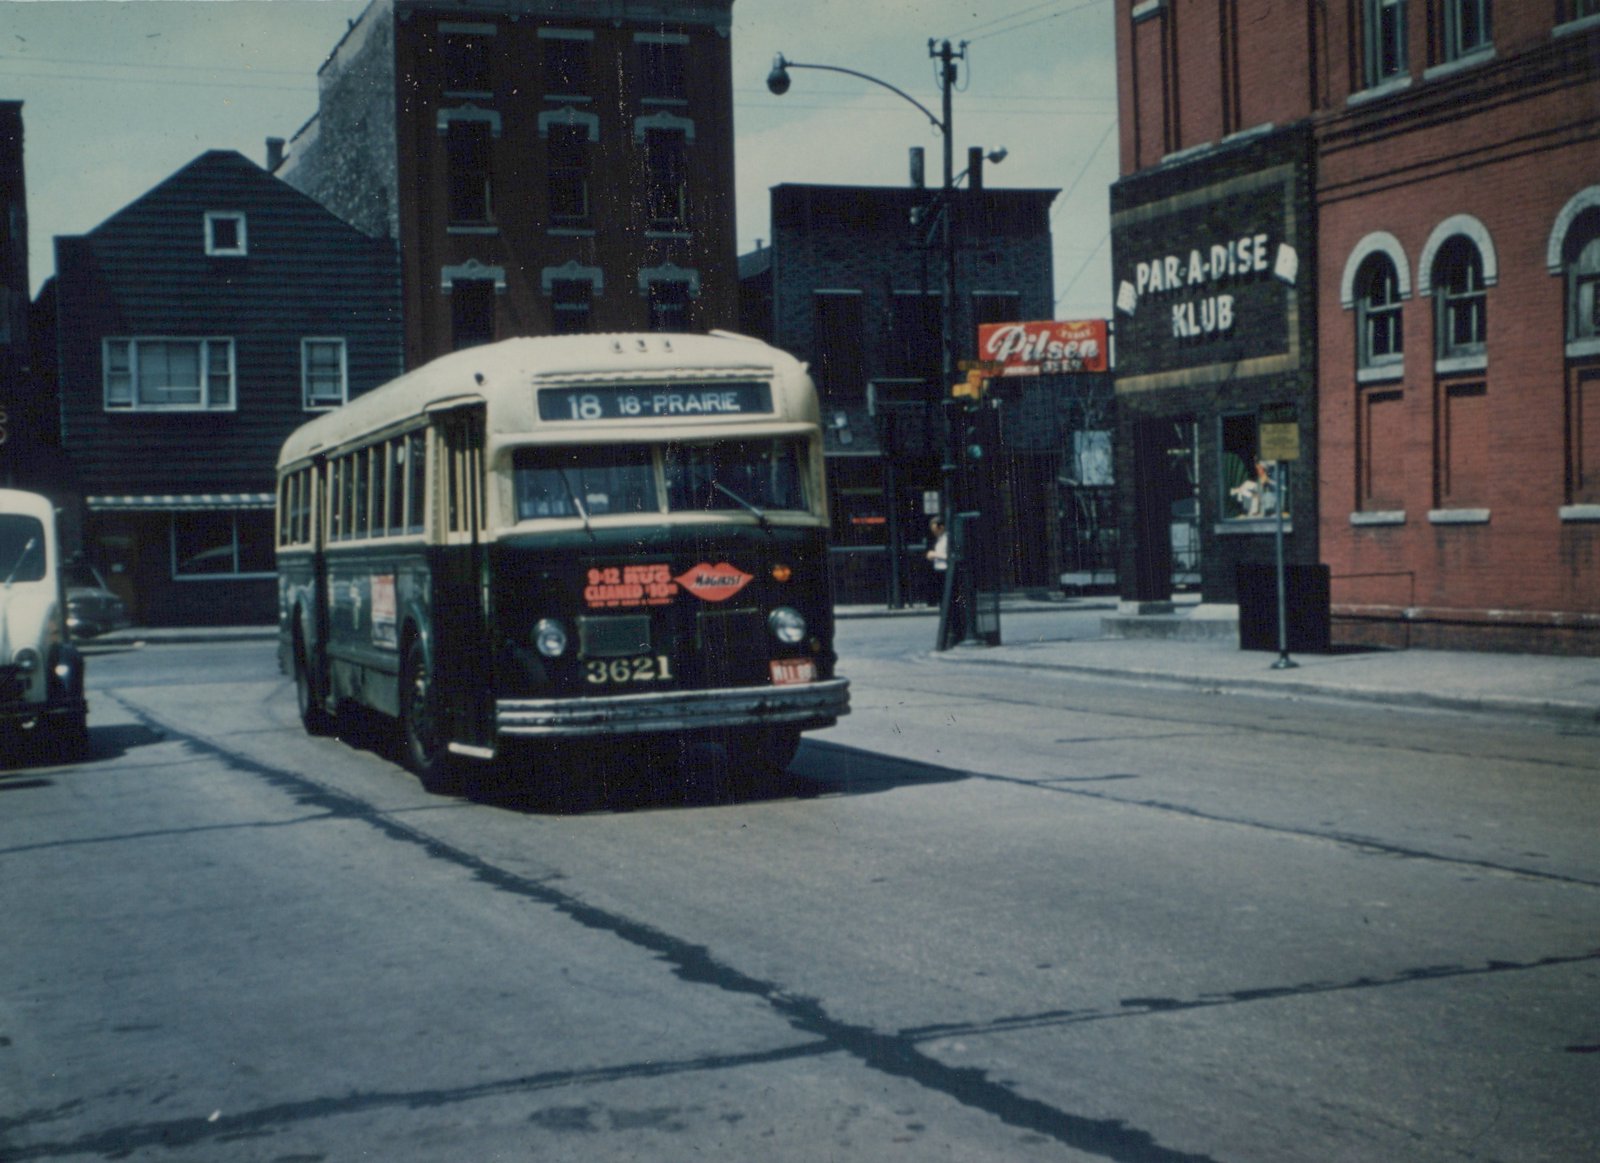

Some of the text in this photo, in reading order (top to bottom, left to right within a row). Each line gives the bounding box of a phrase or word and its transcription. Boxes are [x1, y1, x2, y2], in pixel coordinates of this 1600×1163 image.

[1137, 234, 1268, 295] PAR-A-DISE
[1172, 294, 1235, 338] KLUB
[986, 324, 1099, 362] Pilsen
[567, 394, 602, 420] 18
[587, 655, 673, 684] 3621
